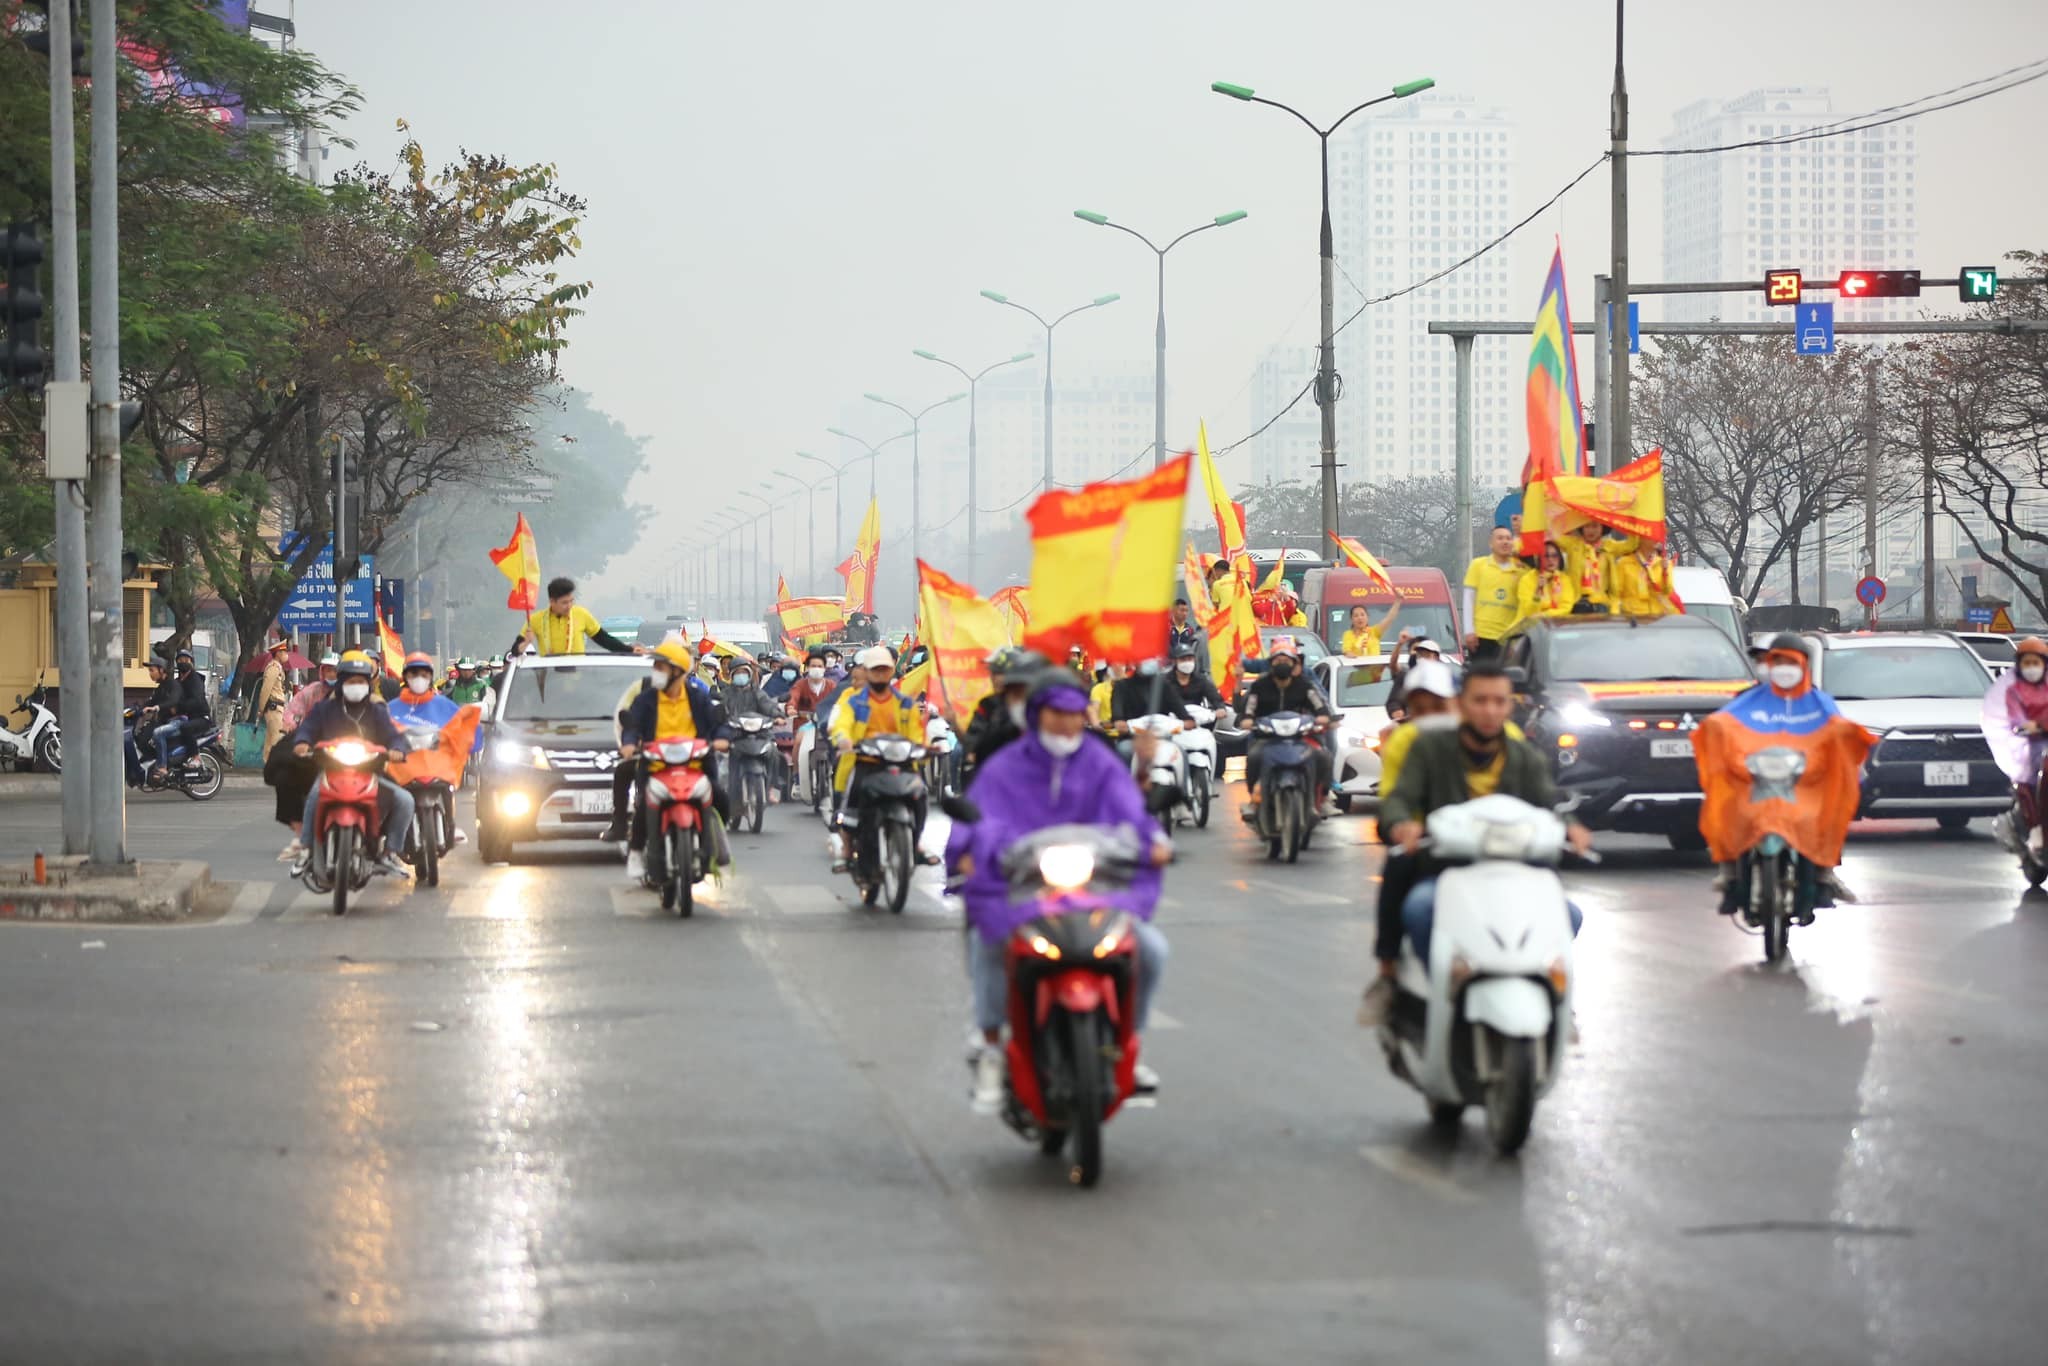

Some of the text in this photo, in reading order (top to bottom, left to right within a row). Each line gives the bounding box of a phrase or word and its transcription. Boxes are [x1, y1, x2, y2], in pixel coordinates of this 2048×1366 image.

[1771, 275, 1797, 299] 29
[1965, 272, 1992, 295] 74
[316, 585, 326, 593] TP
